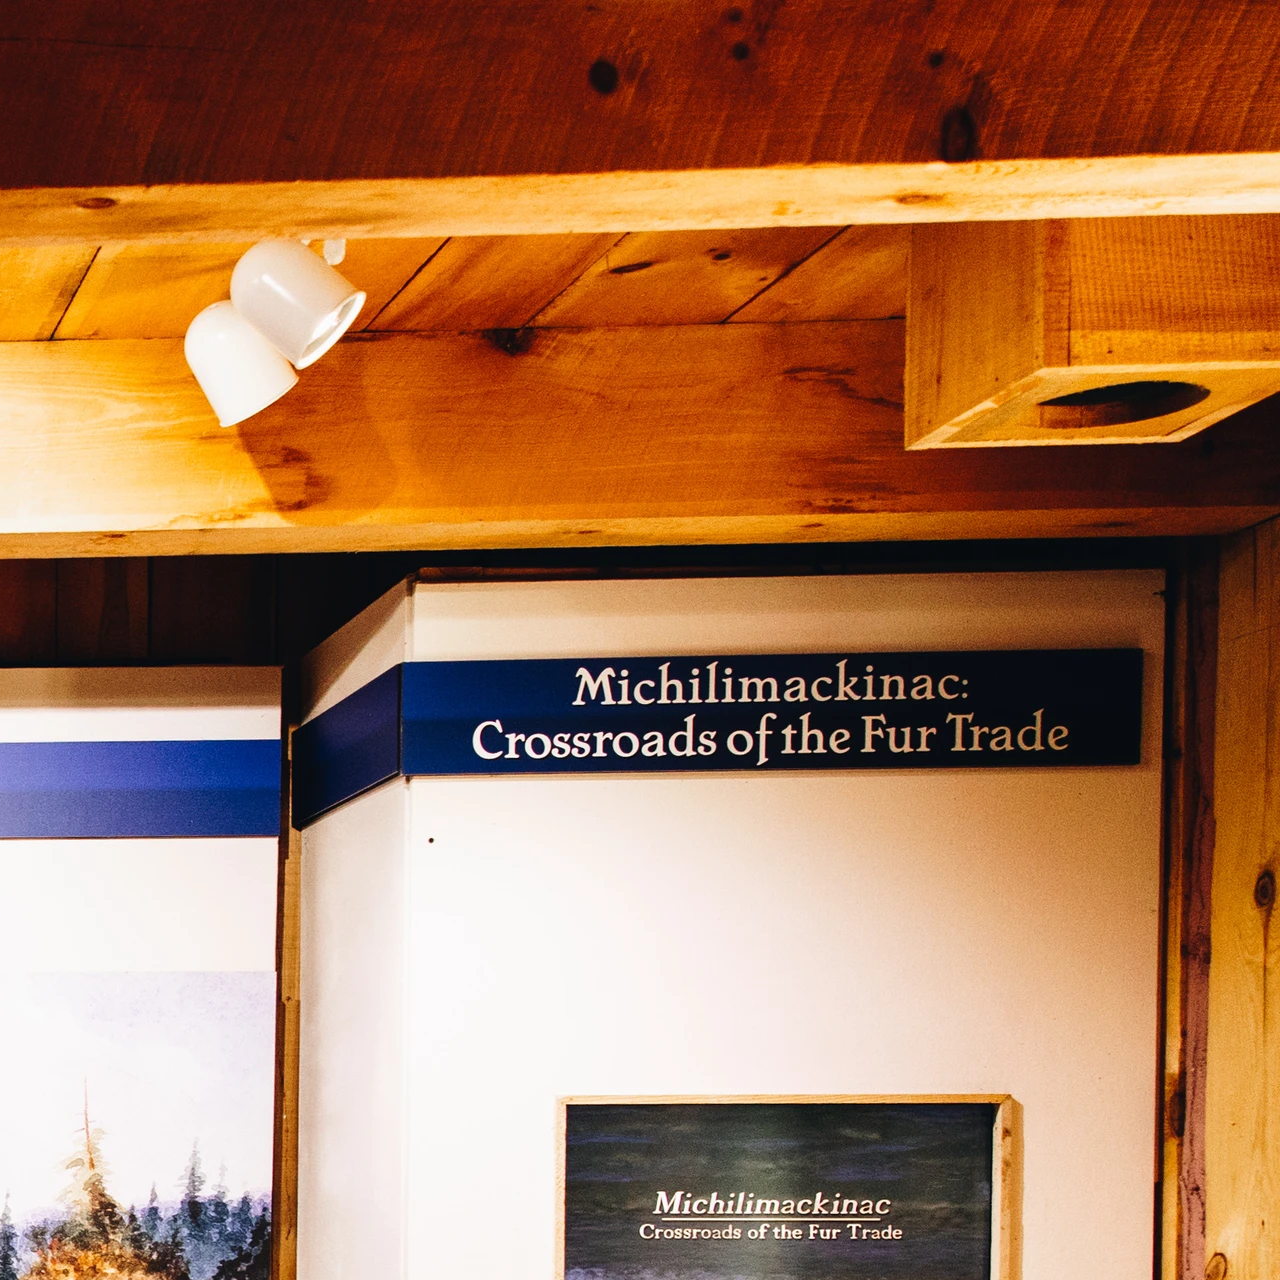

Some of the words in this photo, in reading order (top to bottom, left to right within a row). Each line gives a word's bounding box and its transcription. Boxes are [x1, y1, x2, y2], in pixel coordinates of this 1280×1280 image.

[572, 660, 968, 704] Michilimackinac:
[472, 714, 717, 759] Crossroads
[727, 713, 777, 766] of
[781, 712, 850, 754] the
[860, 713, 936, 753] Fur
[946, 709, 1068, 751] Trade
[652, 1191, 891, 1216] Michilimackinac
[639, 1223, 742, 1239] Crossroads
[748, 1223, 771, 1239] of
[772, 1224, 803, 1239] the
[808, 1224, 841, 1239] Fur
[846, 1223, 902, 1240] Trade
